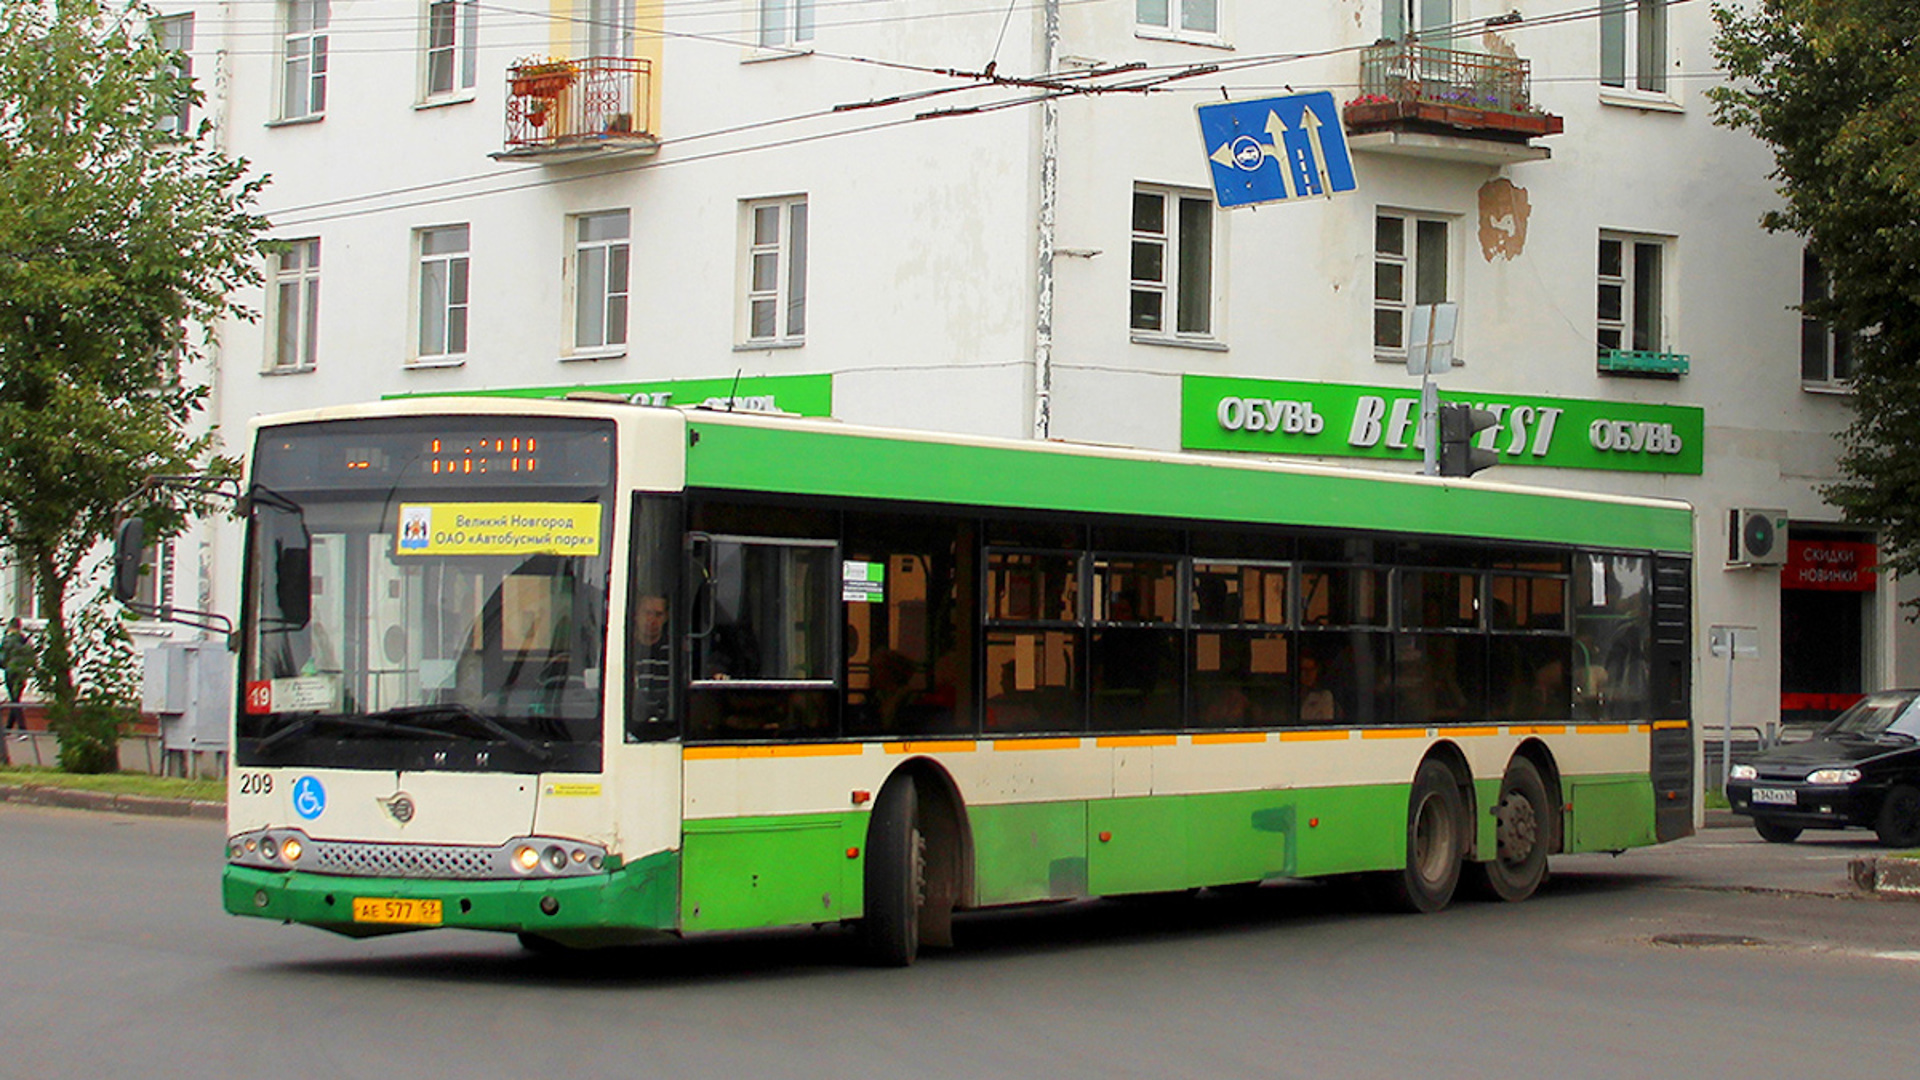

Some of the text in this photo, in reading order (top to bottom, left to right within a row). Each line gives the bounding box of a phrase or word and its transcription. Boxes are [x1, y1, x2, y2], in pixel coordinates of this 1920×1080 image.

[1218, 396, 1325, 435] ОБУВЬ
[1589, 418, 1683, 455] ОБУВЬ
[456, 514, 574, 529] Великий Новгород
[435, 531, 466, 544] ОАО
[1803, 547, 1854, 563] СКИДКИ
[1799, 567, 1858, 583] НОВИНКИ
[250, 686, 270, 707] 19
[240, 773, 273, 794] 209
[386, 901, 412, 919] 577
